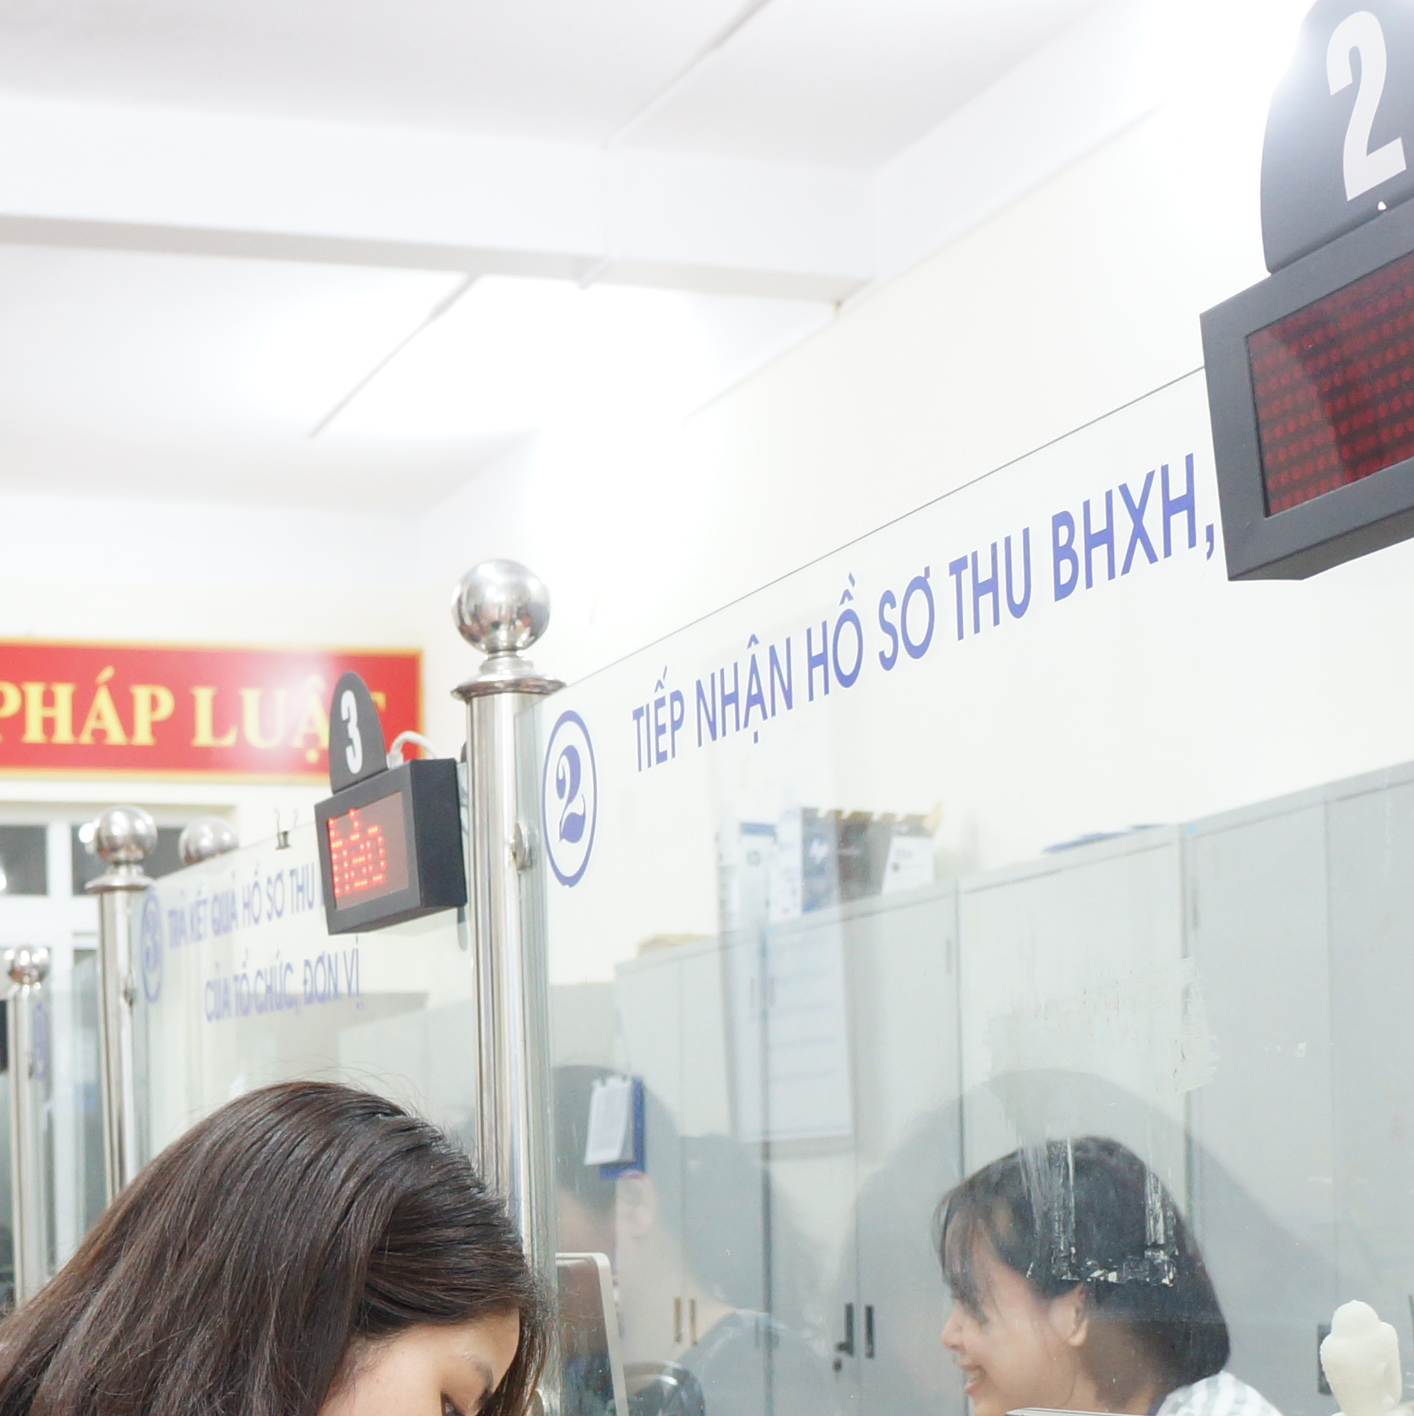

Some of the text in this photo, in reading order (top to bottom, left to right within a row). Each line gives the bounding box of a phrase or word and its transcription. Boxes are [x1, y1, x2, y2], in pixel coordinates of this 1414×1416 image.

[1325, 10, 1406, 201] 2
[632, 452, 1215, 773] TIẾP NHẬN HỒ SƠ THU BHXH,
[192, 673, 386, 762] LUẬ
[341, 689, 363, 774] 3
[556, 744, 586, 842] 2
[242, 861, 262, 927] HỒ
[266, 868, 285, 921] SƠ
[289, 861, 315, 915] THU
[303, 952, 340, 1005] ĐƠN
